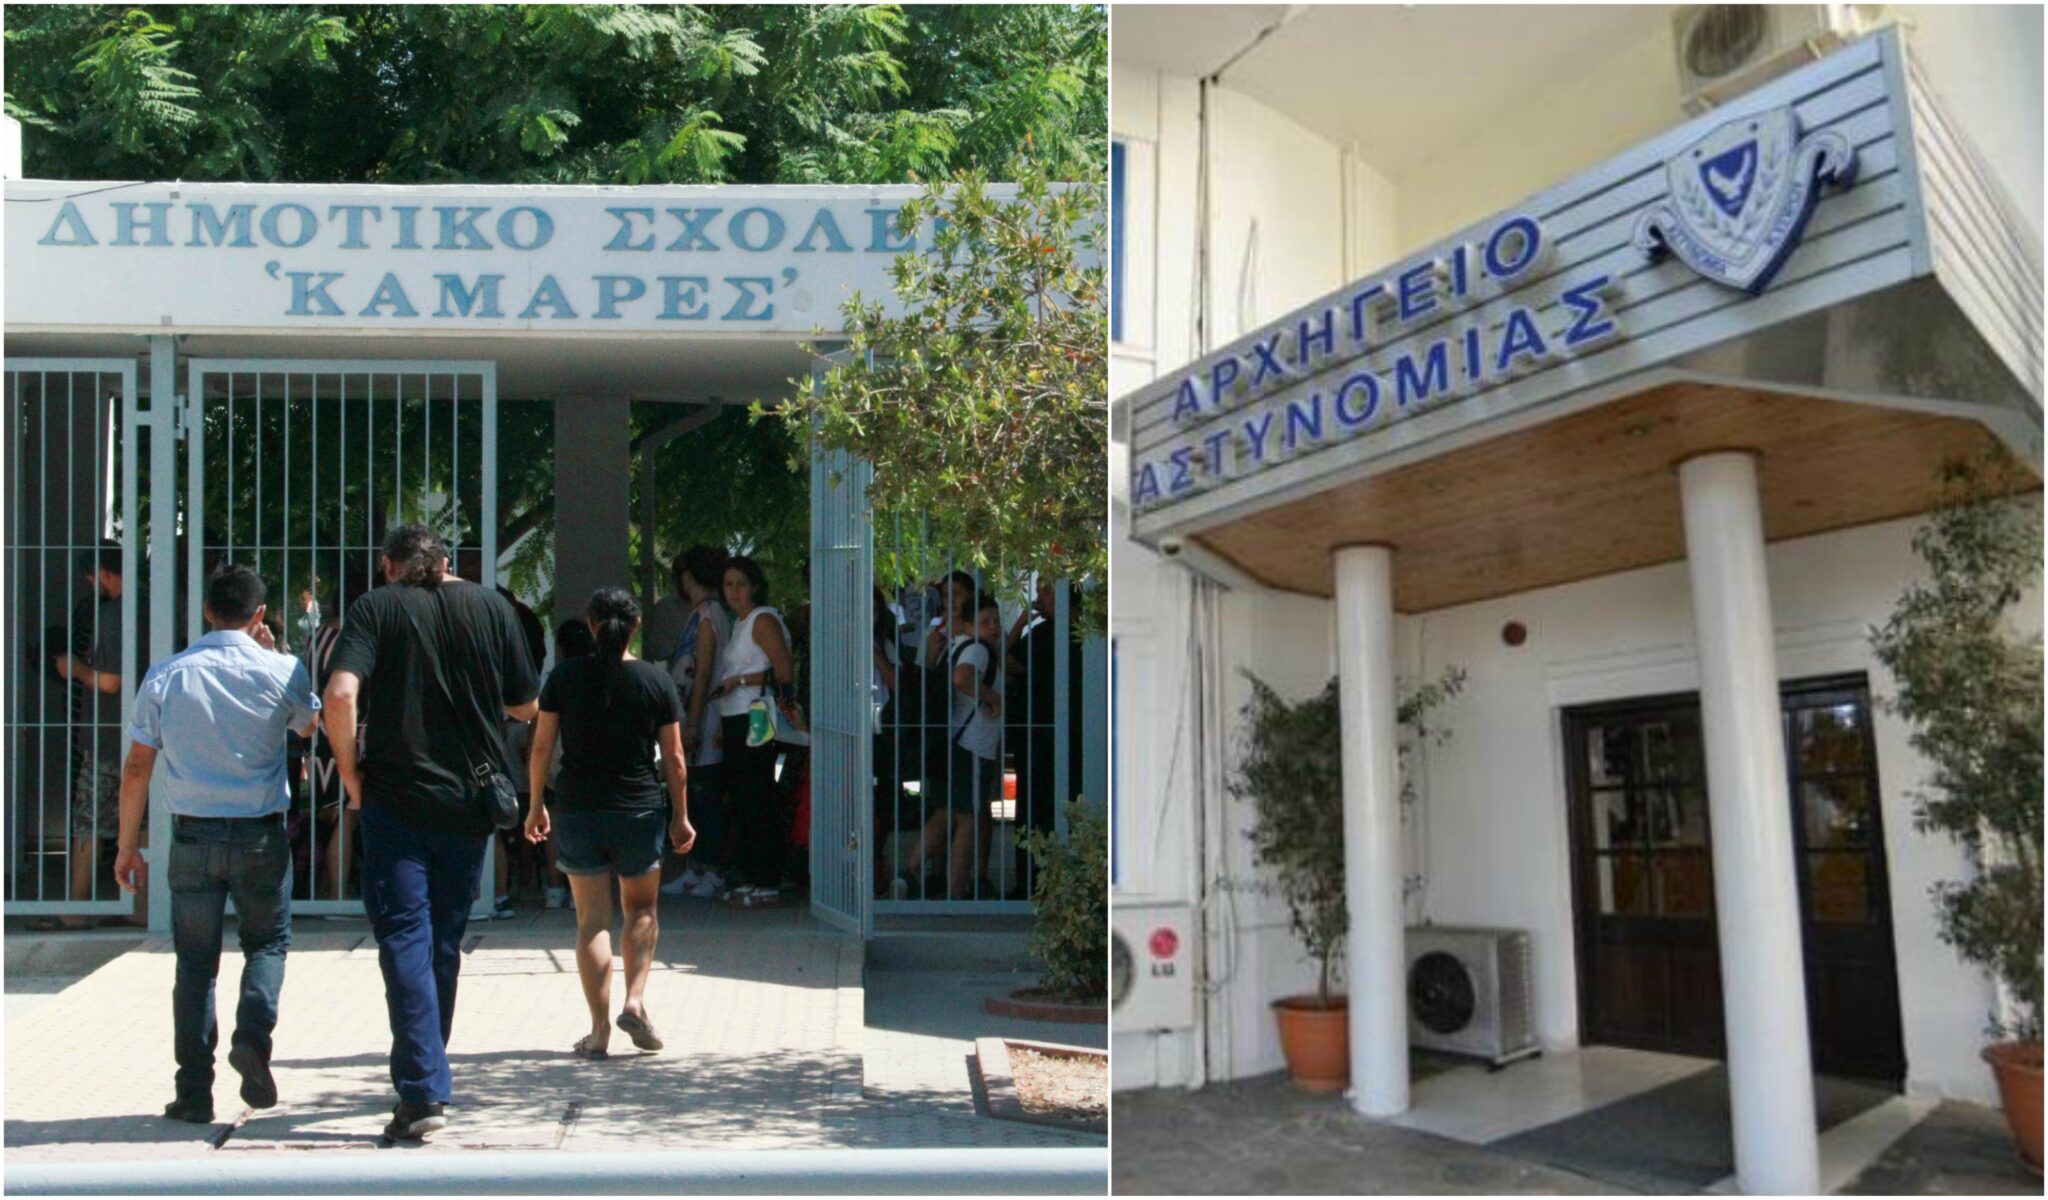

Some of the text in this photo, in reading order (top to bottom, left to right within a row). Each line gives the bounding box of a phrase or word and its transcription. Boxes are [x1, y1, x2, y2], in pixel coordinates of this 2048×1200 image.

[37, 201, 1003, 254] ΔΗΜΟΤΙΚΟ ΣΧΟΛΕ
[1172, 216, 1541, 422] ΑΡΧΗΓΕΙΟ
[1134, 275, 1614, 503] ΑΣΤΥΝΟΜΙΑΣ
